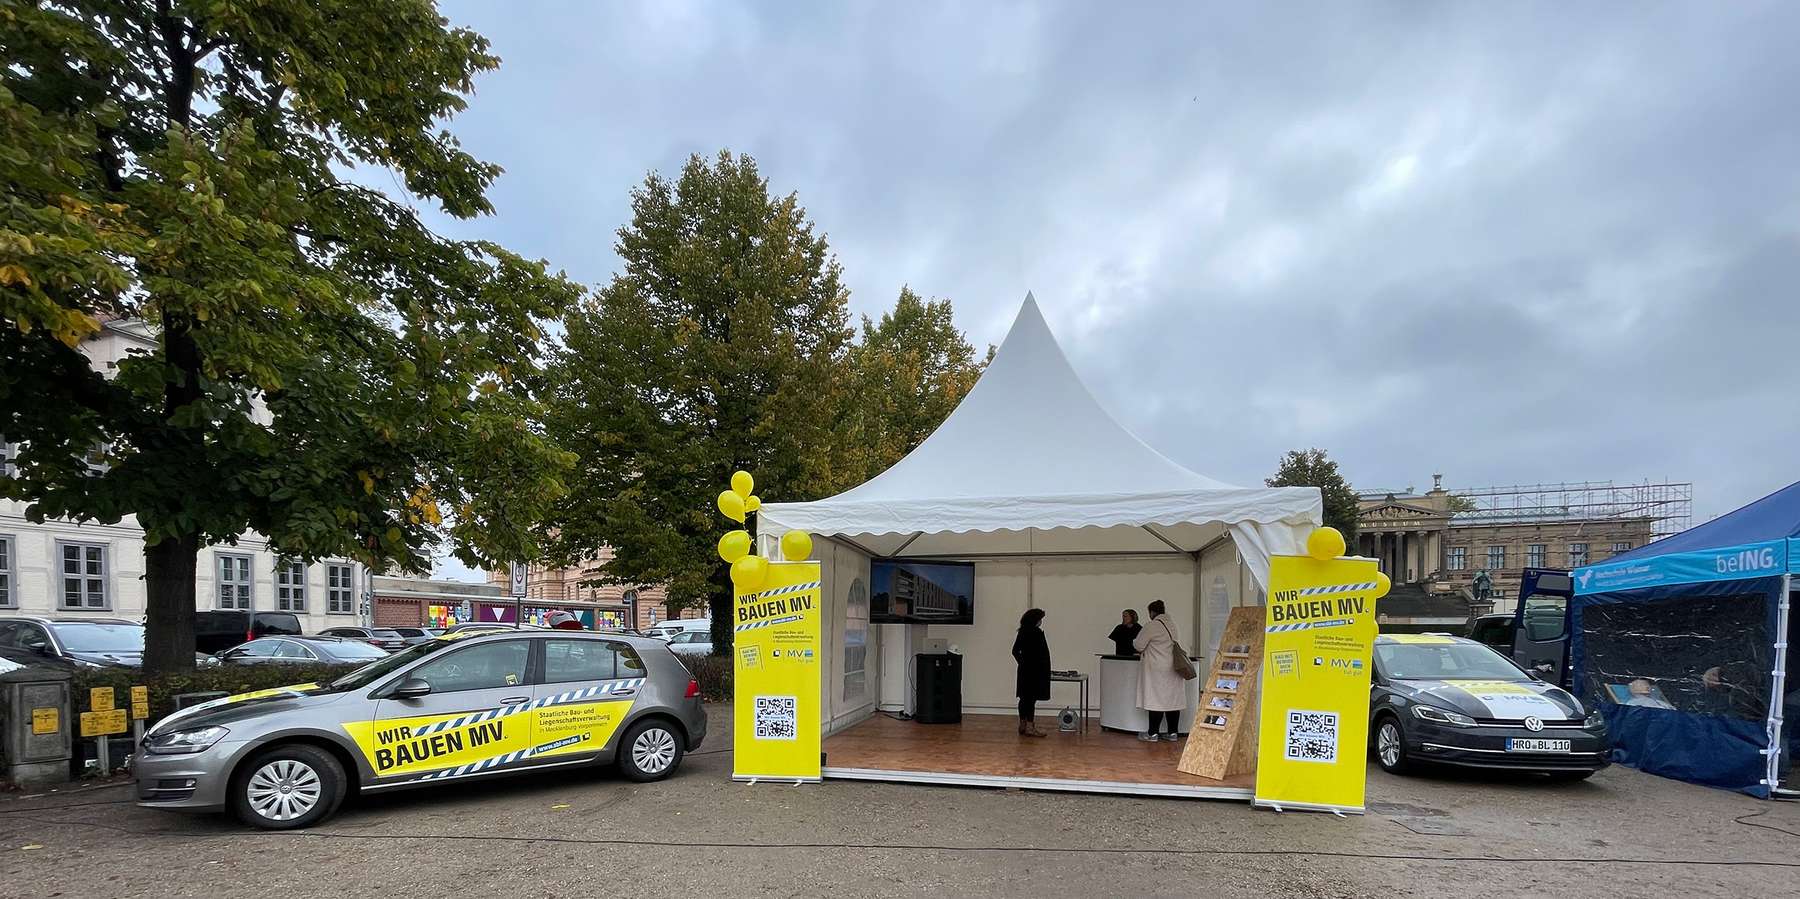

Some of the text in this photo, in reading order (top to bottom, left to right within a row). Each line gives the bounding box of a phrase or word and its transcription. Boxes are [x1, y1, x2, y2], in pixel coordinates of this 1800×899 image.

[1717, 547, 1779, 573] beING.
[739, 593, 758, 605] WIR
[1275, 590, 1298, 602] WIR
[738, 599, 787, 622] BAUEN
[1272, 600, 1333, 621] BAUEN
[787, 649, 804, 657] MV
[1331, 658, 1351, 668] MV
[539, 710, 568, 718] Staatliche
[539, 714, 611, 726] Liegenschaftsverwaltung
[377, 726, 412, 745] WIR
[375, 731, 463, 771] BAUEN
[1512, 740, 1570, 750] HRO BL 110
